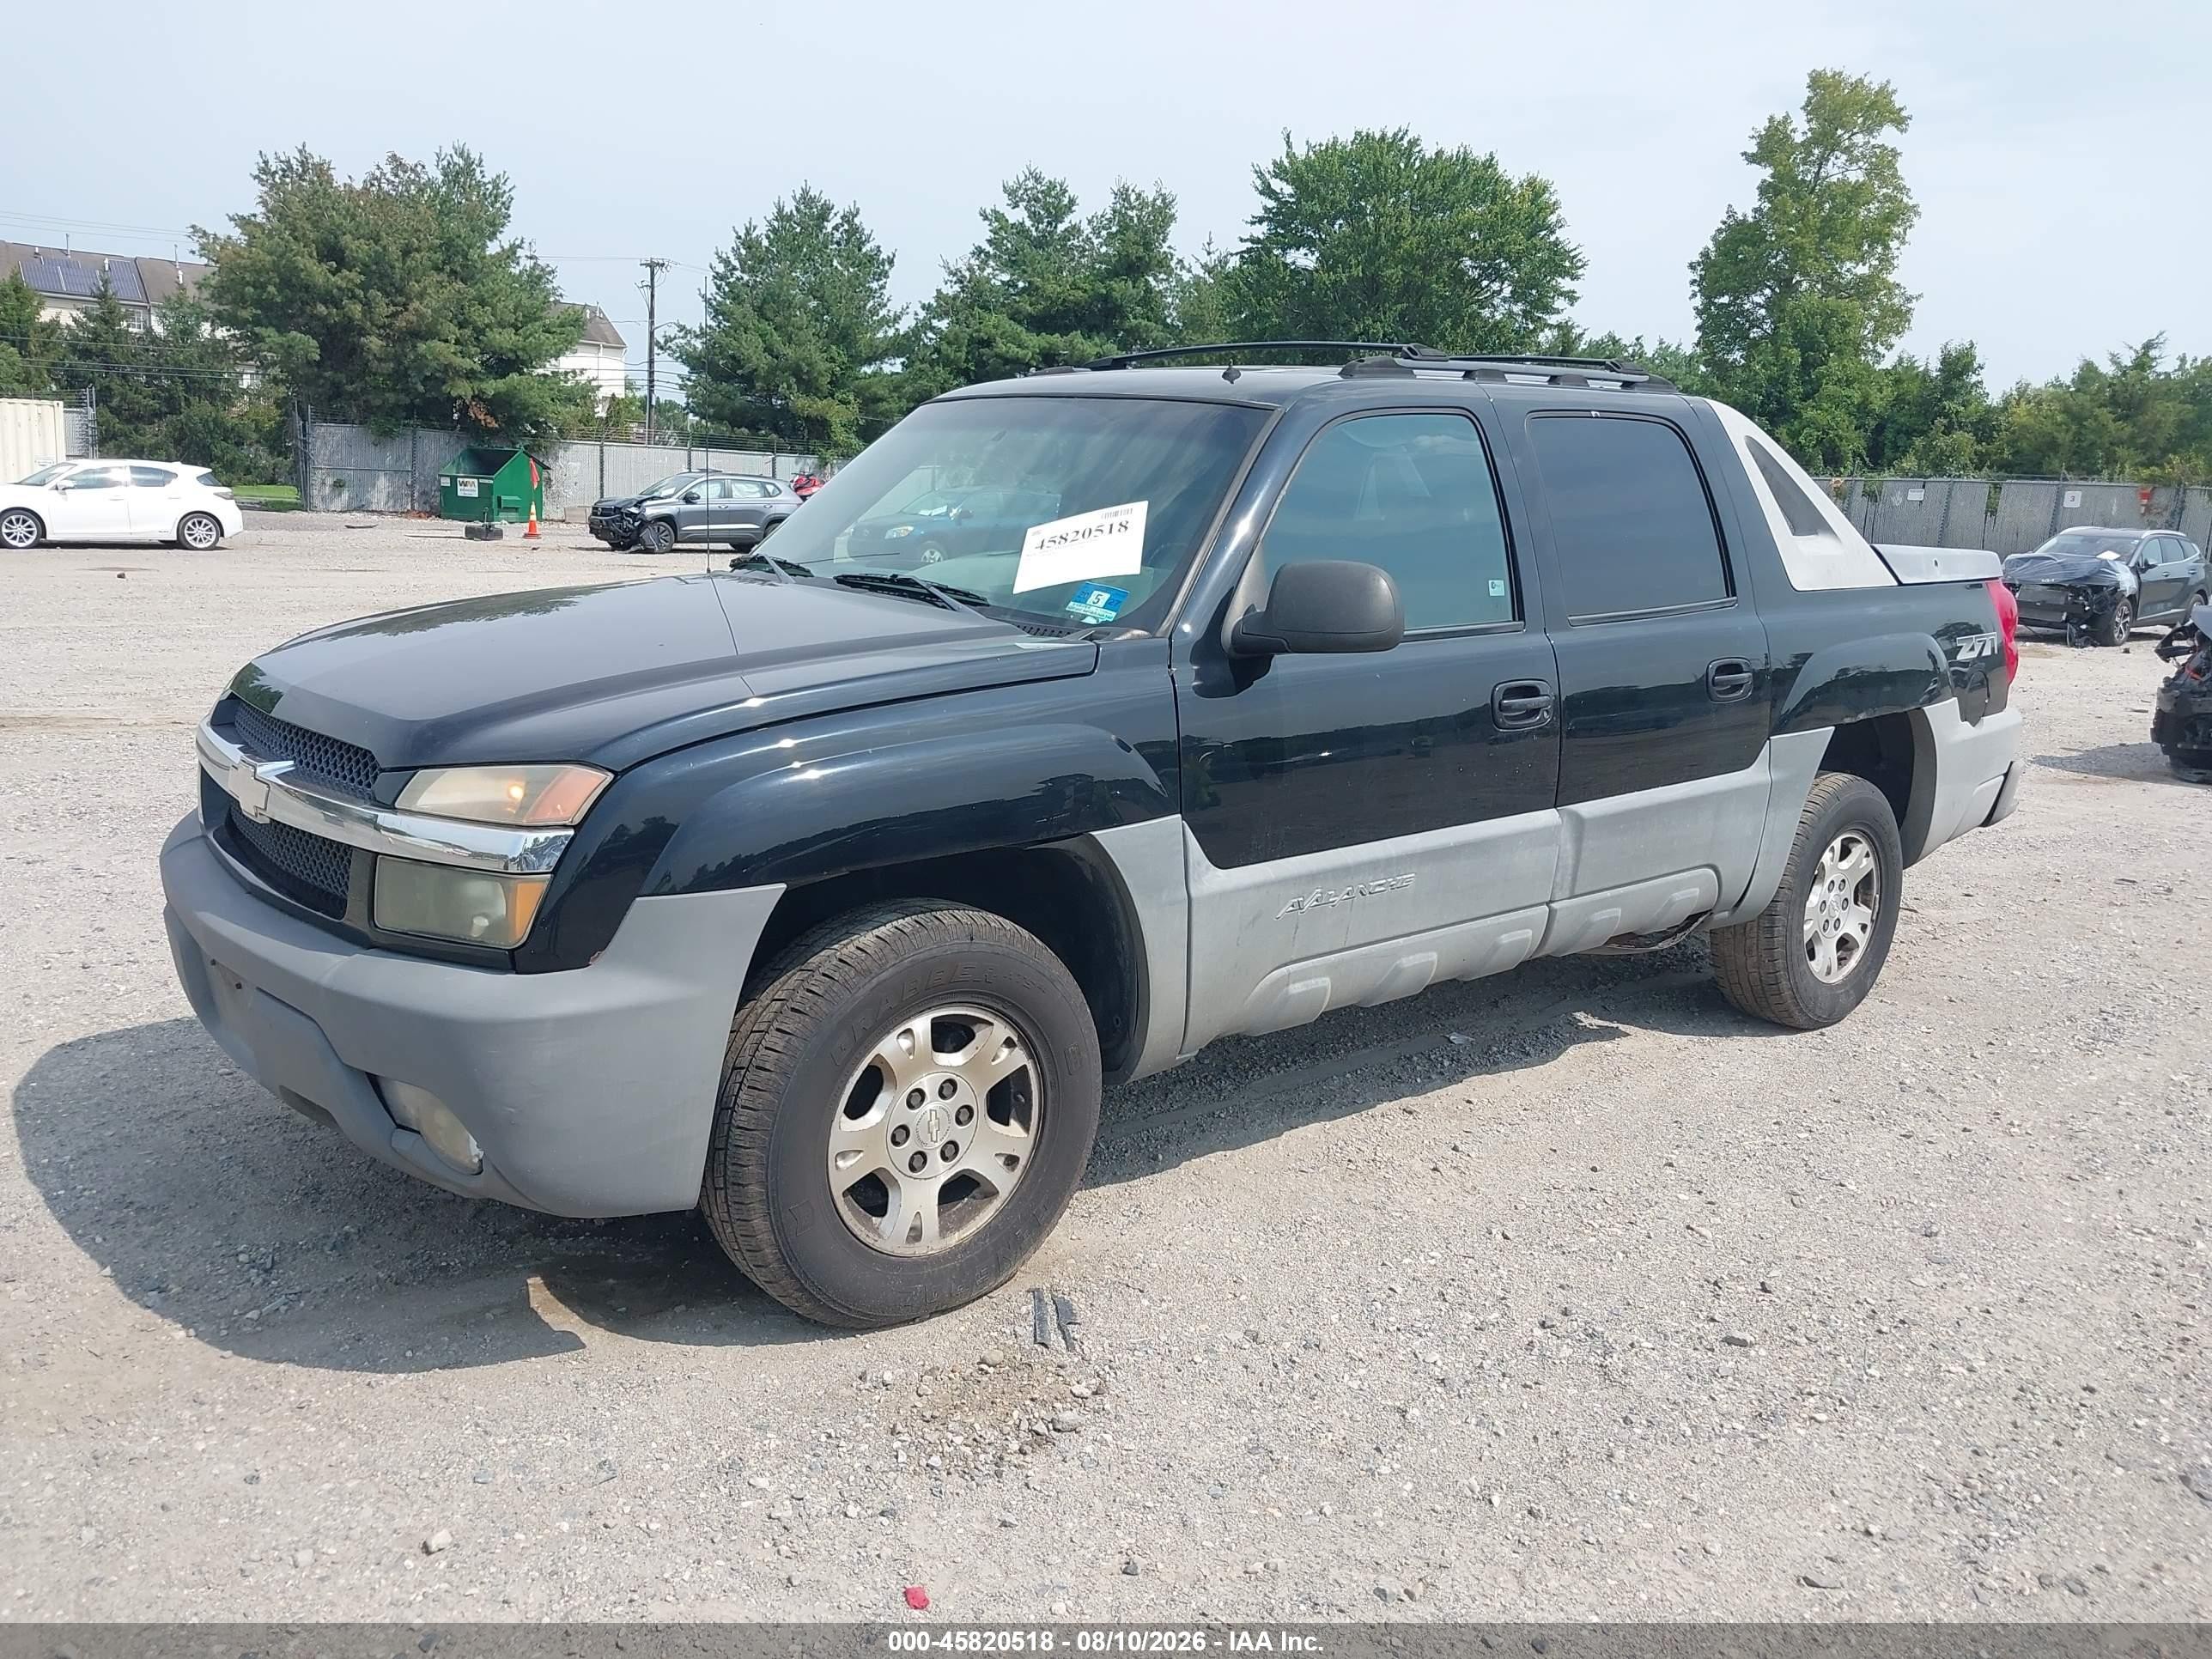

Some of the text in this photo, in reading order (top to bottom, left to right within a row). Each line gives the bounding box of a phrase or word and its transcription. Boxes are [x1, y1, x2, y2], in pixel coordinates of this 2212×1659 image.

[1035, 520, 1129, 550] 45820518
[1091, 593, 1103, 605] 5
[1956, 631, 1998, 660] Z71
[1274, 872, 1415, 921] AVALANCHE
